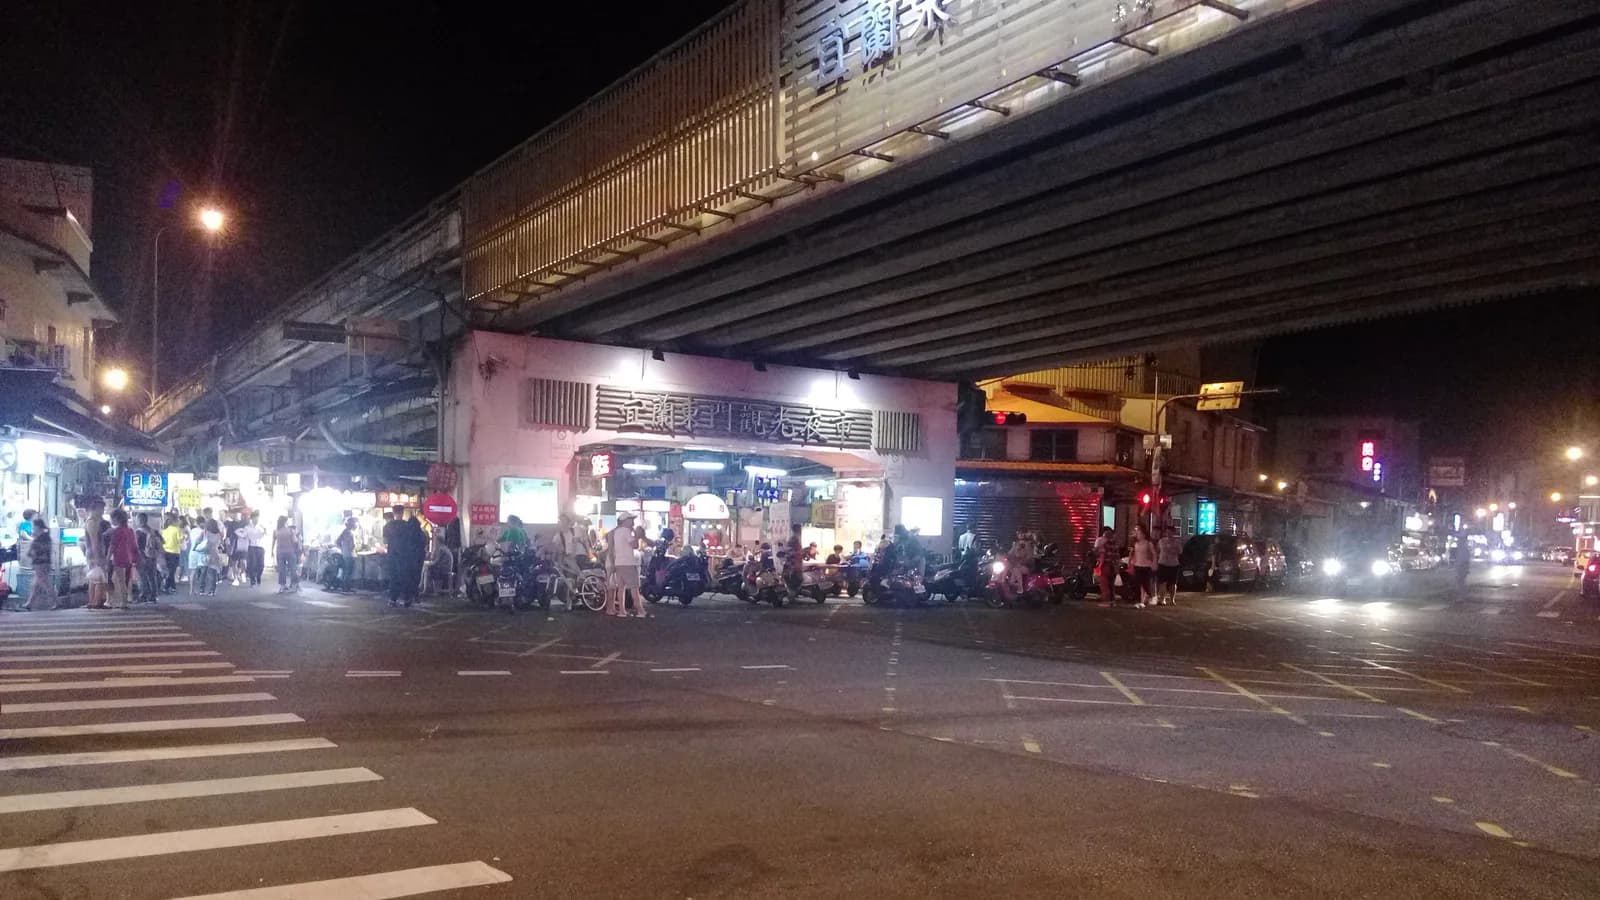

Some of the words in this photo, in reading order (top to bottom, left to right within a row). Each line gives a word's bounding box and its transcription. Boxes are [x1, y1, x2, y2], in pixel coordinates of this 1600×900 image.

[620, 391, 856, 441] 宜蘭東門觀光夜市
